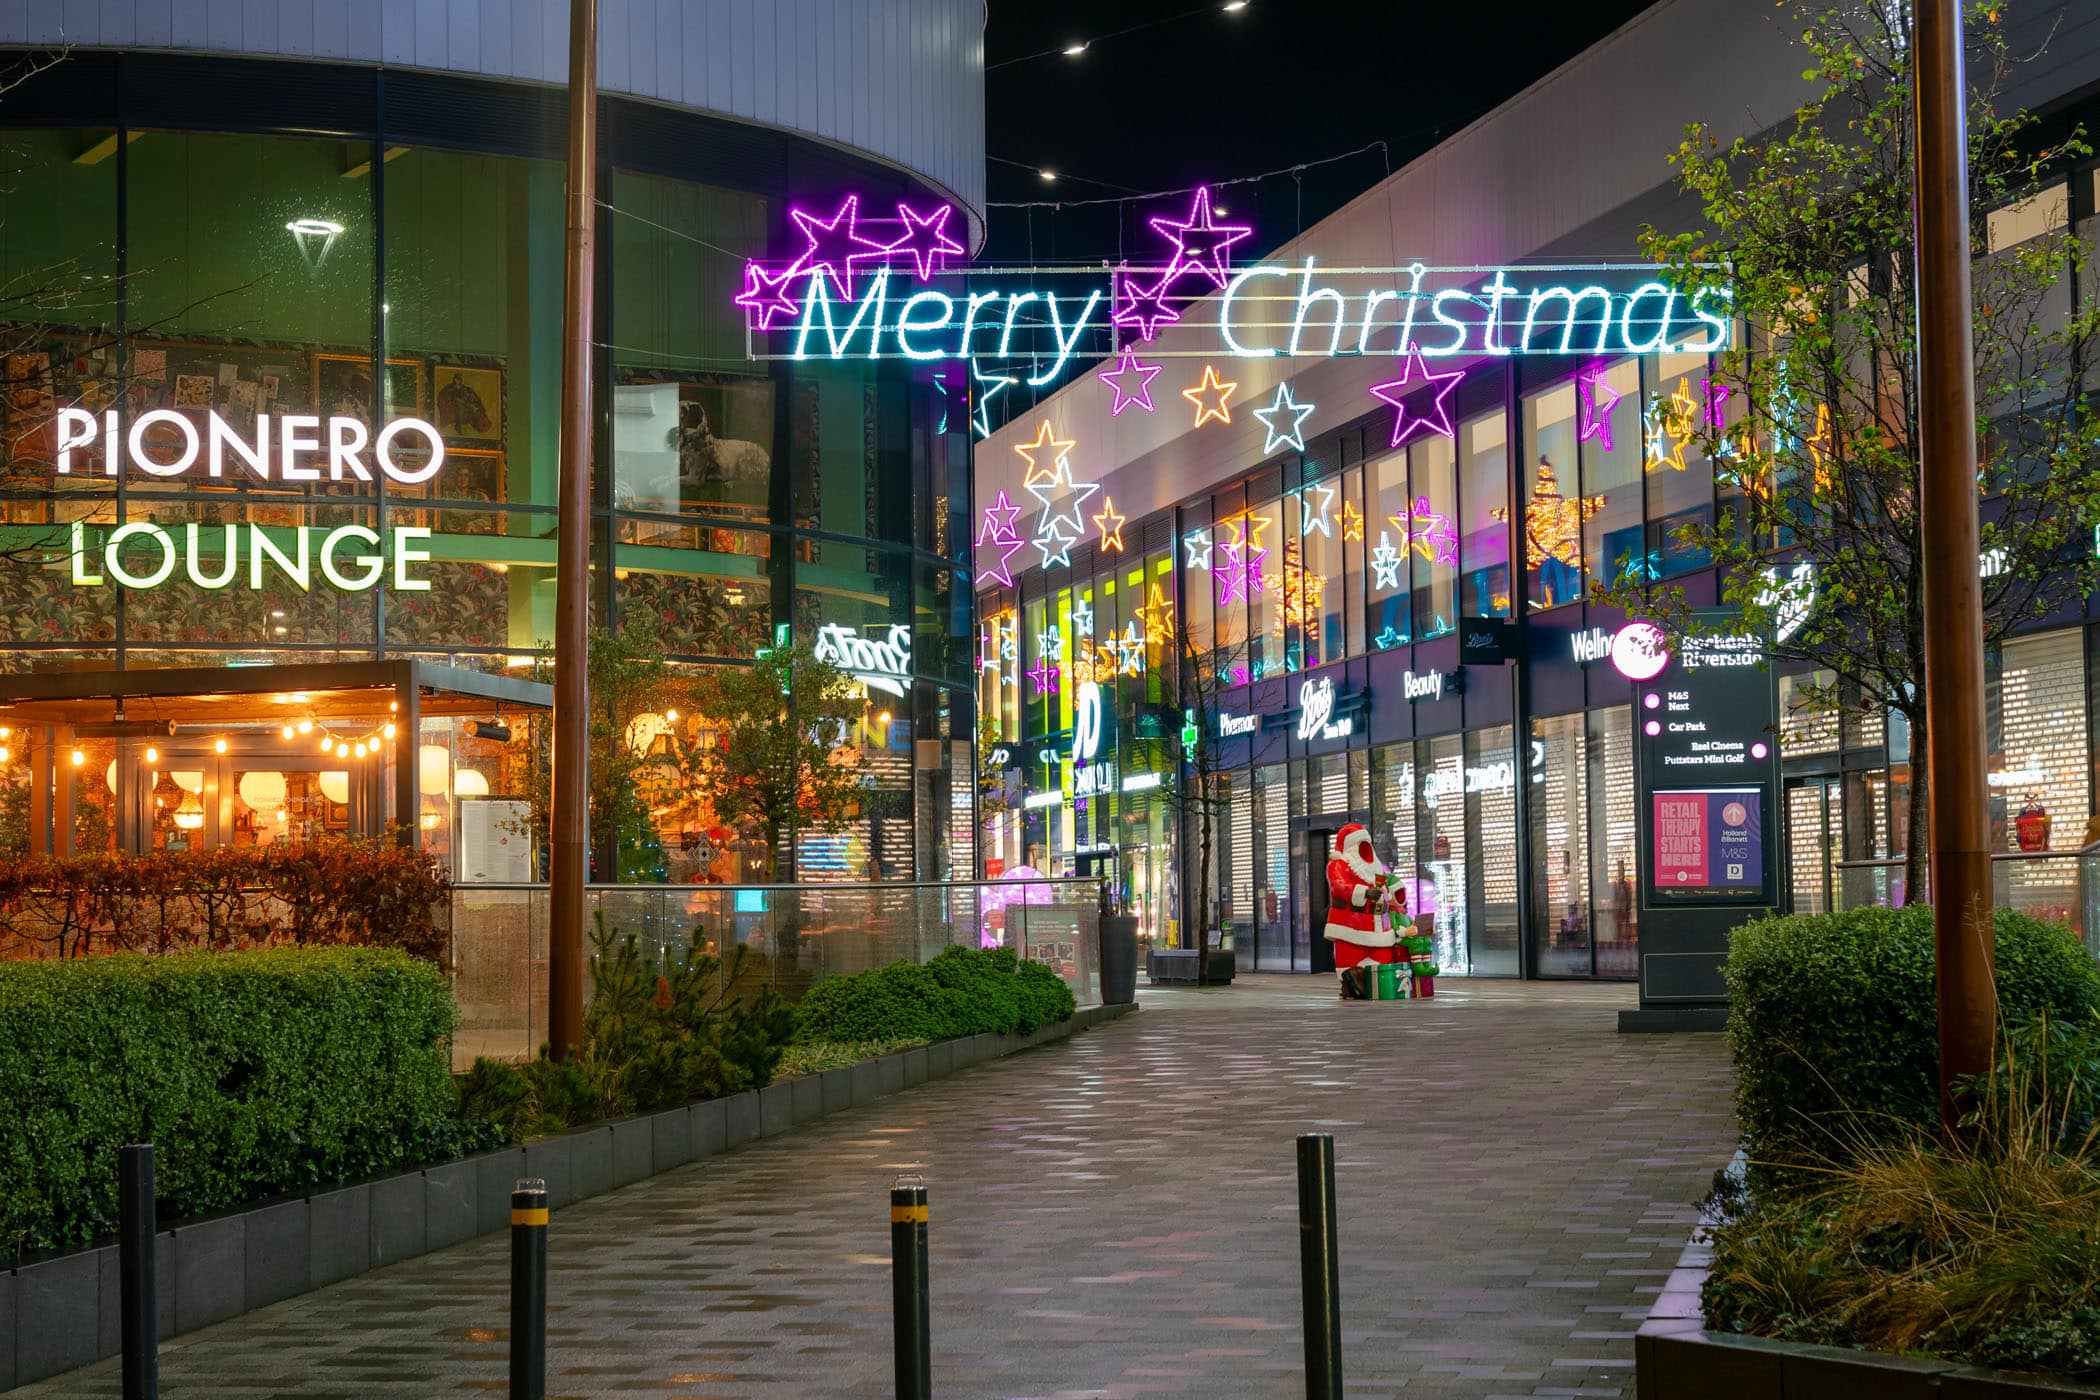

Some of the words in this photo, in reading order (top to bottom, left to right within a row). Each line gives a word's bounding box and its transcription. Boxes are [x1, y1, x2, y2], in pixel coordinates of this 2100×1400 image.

[794, 267, 1101, 385] Merry
[1220, 256, 1732, 356] Christmas
[57, 408, 445, 484] PIONERO
[72, 521, 432, 591] LOUNGE
[1570, 627, 1614, 662] Welln
[1681, 650, 1763, 667] Riverside
[1404, 669, 1442, 700] Beauty
[1668, 692, 1689, 700] M&S
[1668, 702, 1690, 711] Next
[1668, 723, 1685, 731] Car
[1685, 722, 1706, 731] Park
[1691, 742, 1710, 751] Reel
[1711, 742, 1744, 750] Cinema
[1664, 755, 1703, 765] Puttstars
[1704, 755, 1724, 763] Mini
[1725, 754, 1744, 763] Golf
[1660, 802, 1701, 818] RETAIL
[1660, 819, 1701, 836] THERAPY
[1660, 837, 1701, 853] STARTS
[1721, 848, 1748, 859] M&S
